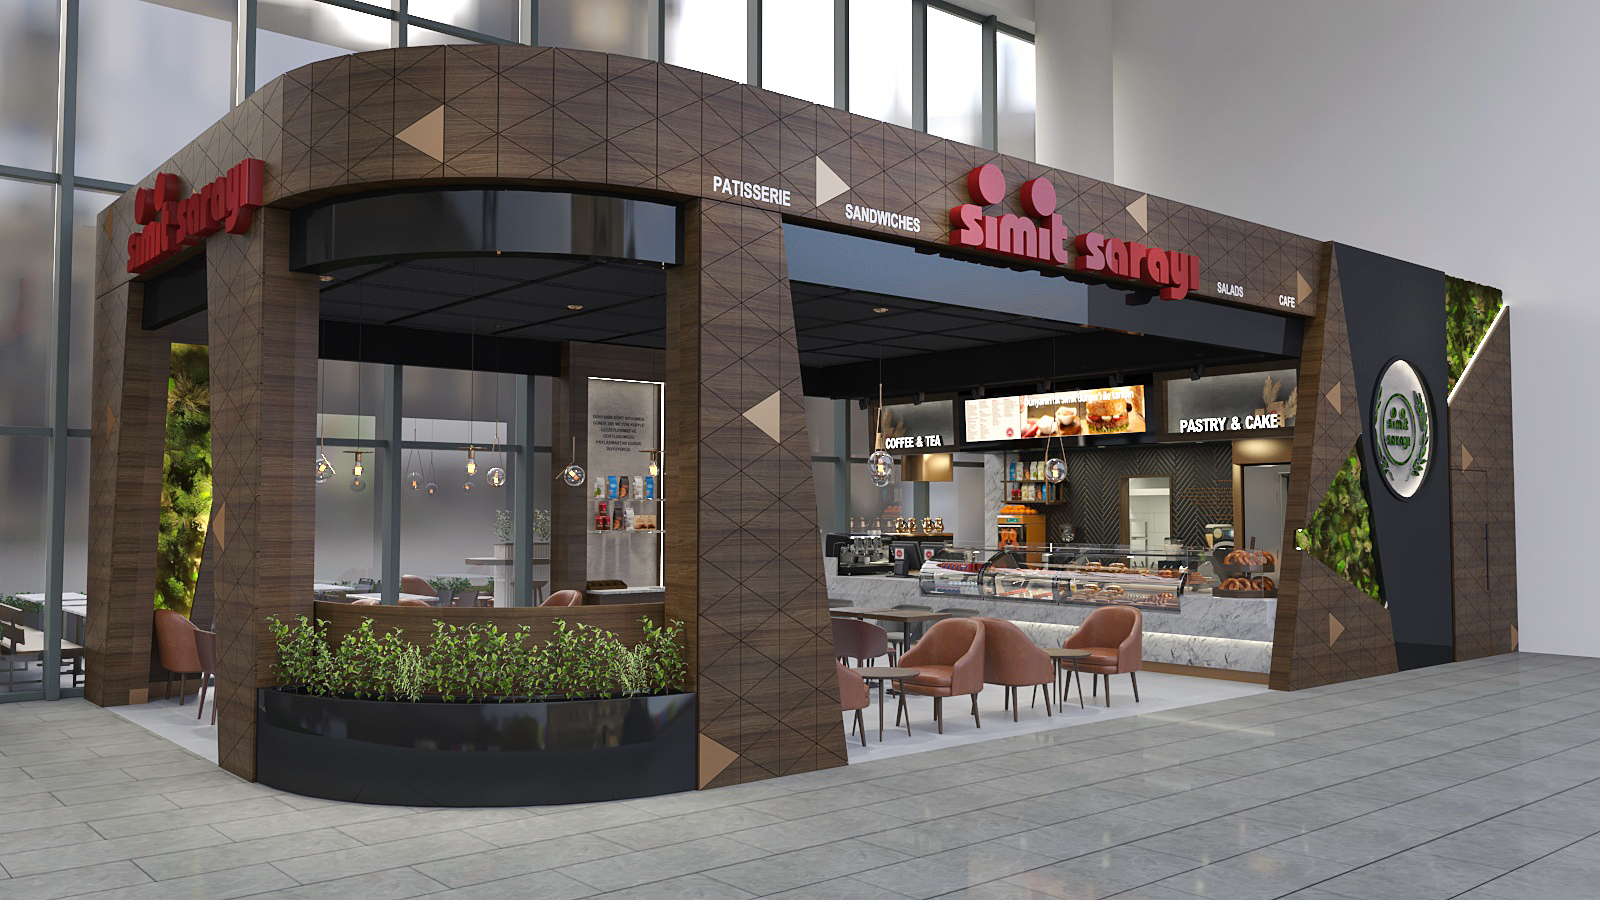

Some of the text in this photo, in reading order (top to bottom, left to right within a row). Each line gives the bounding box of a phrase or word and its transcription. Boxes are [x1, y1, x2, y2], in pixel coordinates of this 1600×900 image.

[713, 175, 792, 207] PATISSERIE
[845, 203, 921, 234] SANDWICHES
[1217, 281, 1244, 298] SALADS
[1279, 294, 1296, 309] CAFE
[1179, 413, 1278, 433] PASTRY & CAKE
[885, 434, 941, 449] COFFEE & TEA
